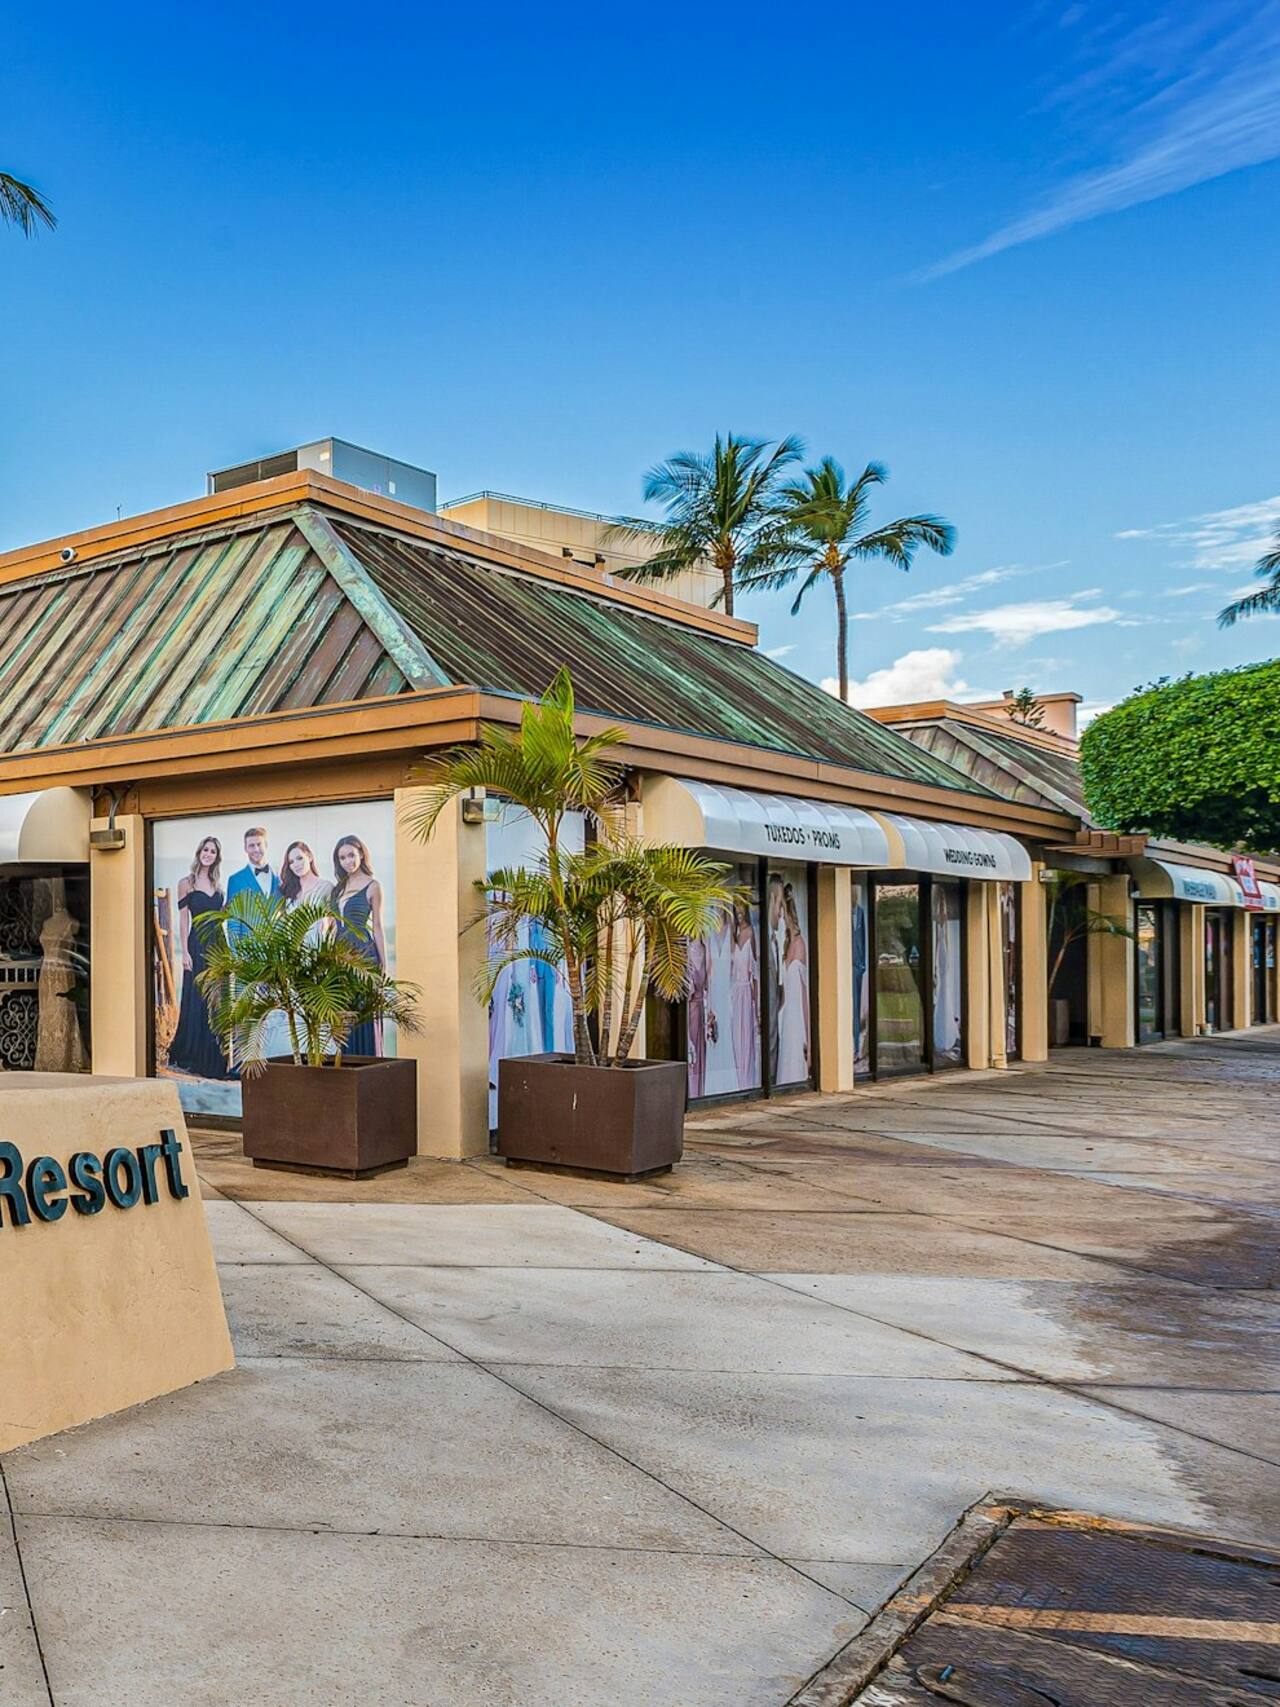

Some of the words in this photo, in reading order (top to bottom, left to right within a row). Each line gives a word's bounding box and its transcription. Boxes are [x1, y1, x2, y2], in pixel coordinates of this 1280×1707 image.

[765, 824, 805, 844] TUXEDOS
[812, 830, 841, 850] PROMS
[943, 848, 973, 865] WEDDING
[973, 852, 997, 868] GOWNS
